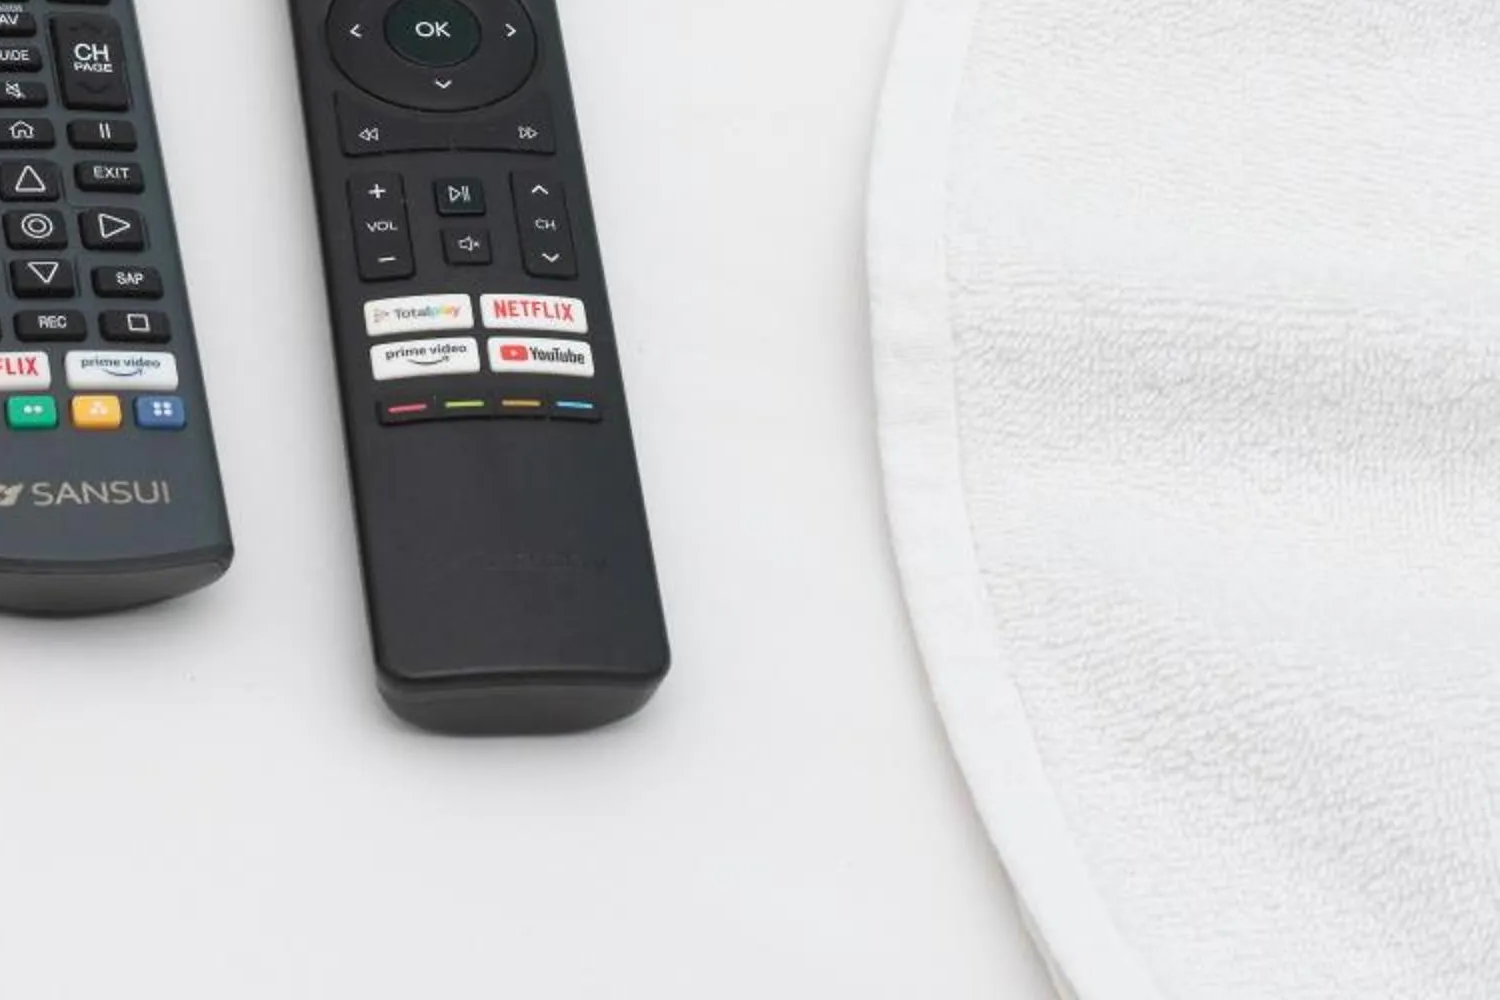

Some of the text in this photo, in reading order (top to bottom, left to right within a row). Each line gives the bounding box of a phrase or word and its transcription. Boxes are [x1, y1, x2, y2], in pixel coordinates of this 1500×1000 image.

[414, 20, 451, 38] OK
[74, 43, 110, 62] CH
[73, 62, 113, 73] PAGE
[93, 166, 130, 180] EXIT
[366, 221, 398, 233] VOL
[534, 218, 557, 231] CH
[116, 271, 145, 285] SAP
[493, 300, 575, 322] NETFLIX
[38, 316, 68, 329] REC
[385, 343, 468, 361] prime video
[529, 346, 586, 365] YouTube
[80, 356, 161, 369] prime video
[30, 480, 171, 507] SANSUI
